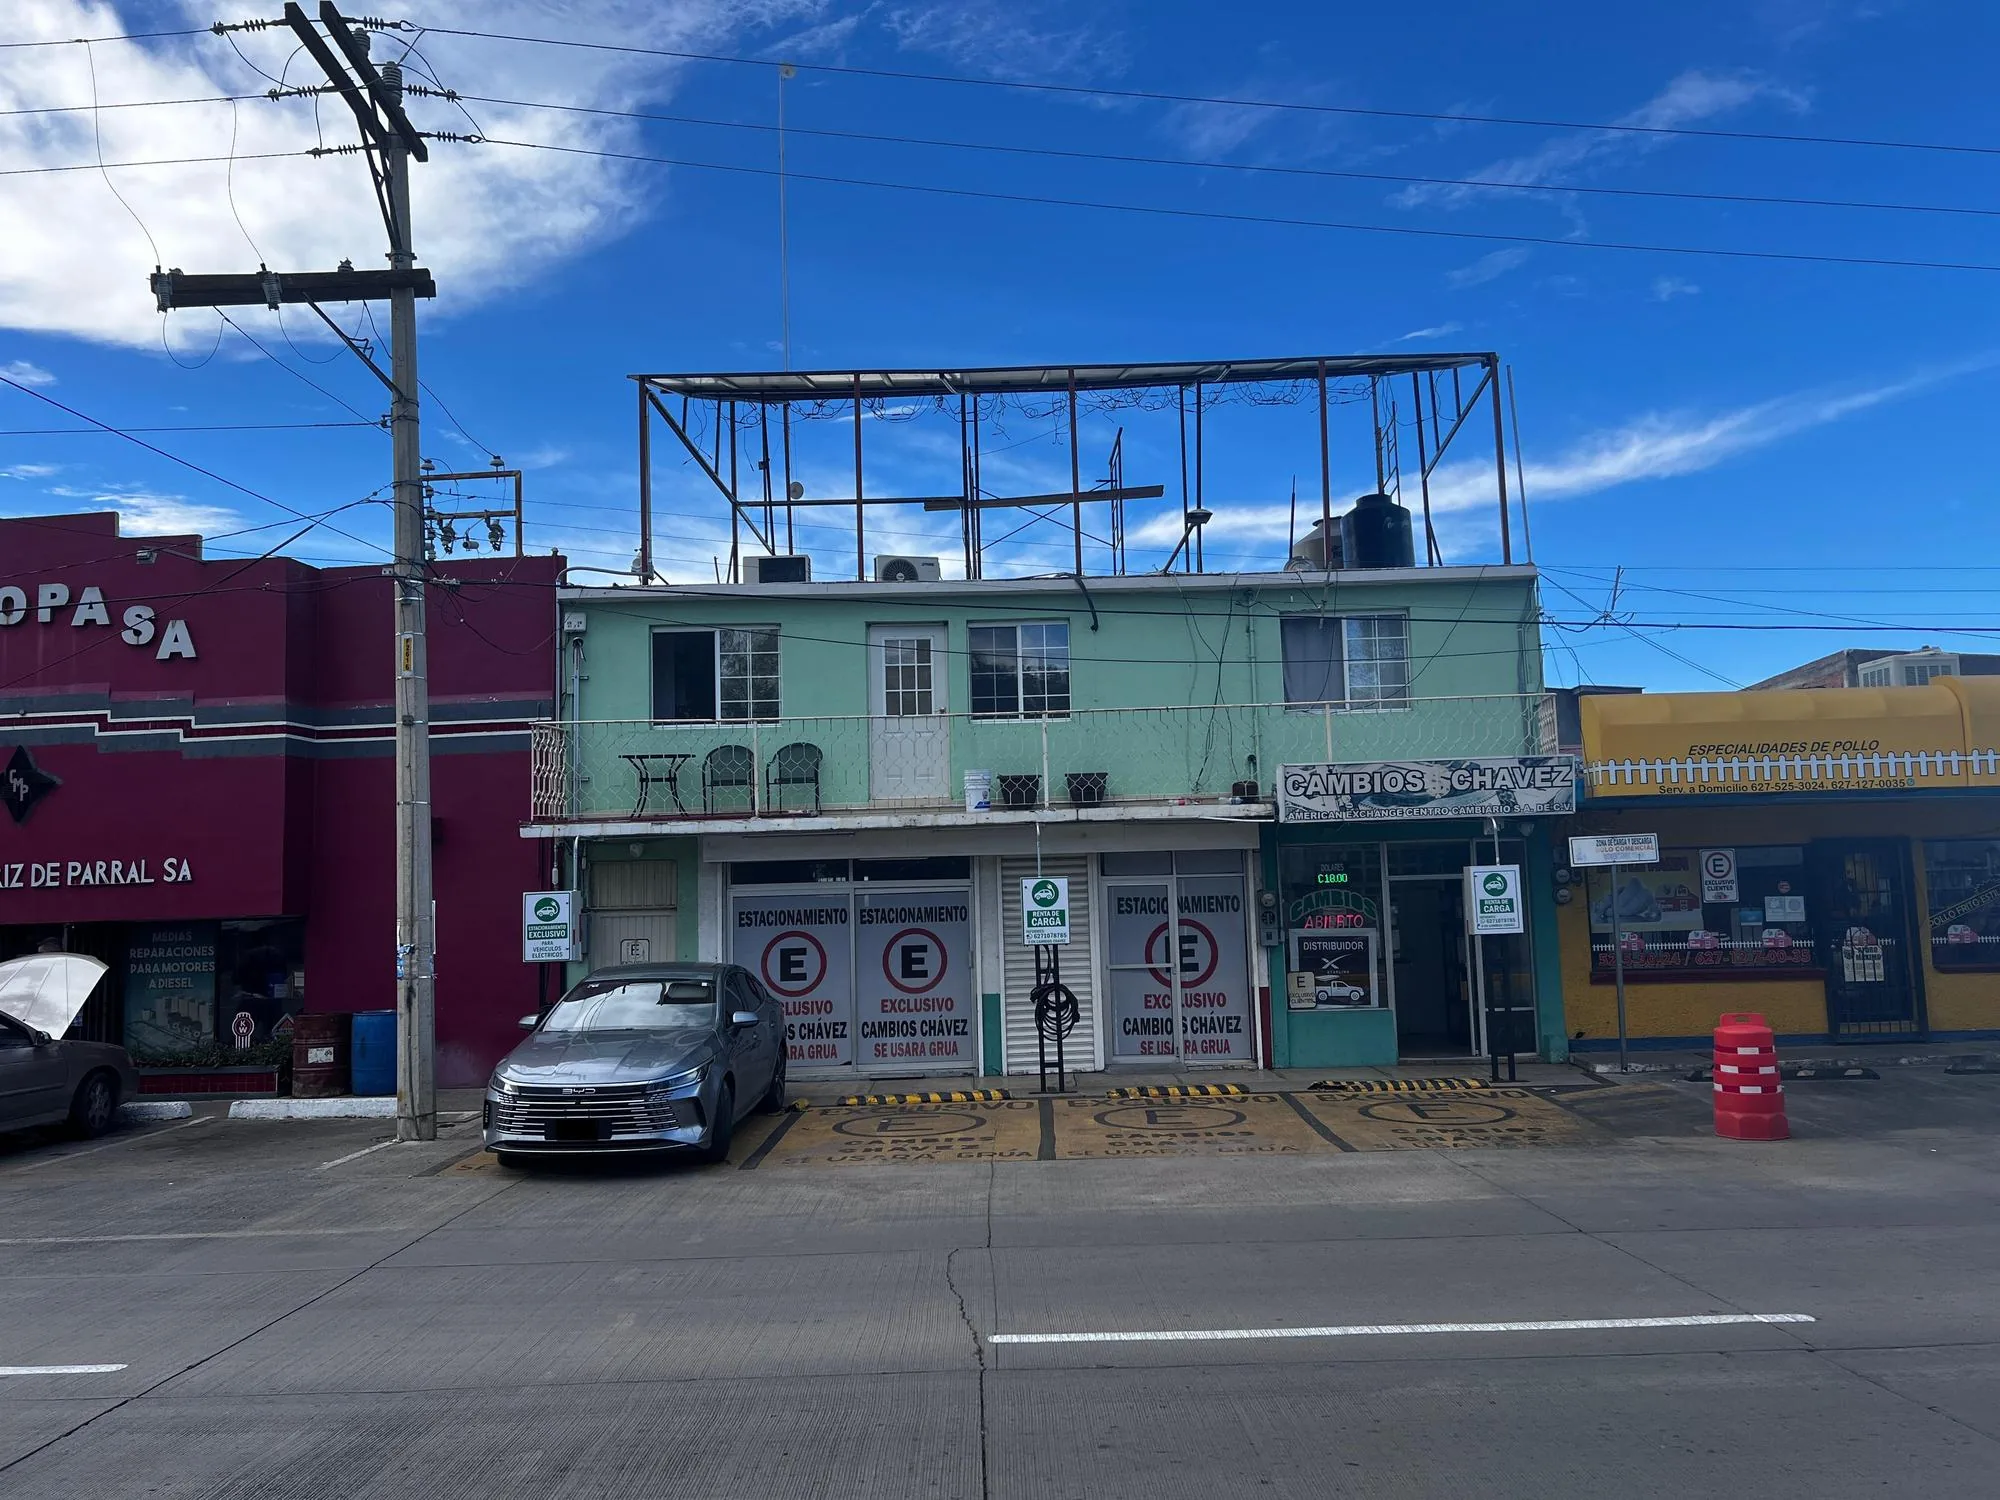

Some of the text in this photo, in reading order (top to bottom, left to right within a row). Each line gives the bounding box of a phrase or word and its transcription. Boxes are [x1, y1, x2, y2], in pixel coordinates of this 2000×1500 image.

[1688, 740, 1880, 756] ESPECIALIDADES DE POLLO
[1285, 769, 1425, 797] CAMBIOS
[1450, 765, 1574, 791] CHAVEZ
[1699, 784, 1749, 793] Domicilio
[1288, 811, 1343, 820] AMERICAN
[1346, 808, 1403, 819] EXCHANGE
[1406, 807, 1449, 816] CENTRO
[1451, 804, 1511, 814] CAMBIARIO
[1535, 803, 1550, 811] DE
[31, 862, 60, 887] DE
[67, 859, 155, 886] PARRAL
[163, 857, 192, 882] SA
[1713, 858, 1724, 873] E
[860, 906, 968, 925] ESTACIONAMIENTO
[1483, 904, 1511, 912] CARGA
[738, 908, 848, 928] ESTACIONAMIENTO
[1031, 917, 1062, 926] CARGA
[152, 931, 193, 942] MEDIAS
[528, 930, 566, 938] EXCLUSIVO
[129, 946, 215, 959] REPARACIONES
[1165, 935, 1200, 972] E
[1303, 941, 1364, 950] DISTRIBUIDOR
[130, 961, 215, 974] PARA MOTORES
[780, 947, 807, 982] E
[901, 944, 929, 979] E
[149, 977, 194, 989] A DIESEL
[1296, 976, 1306, 988] E
[881, 997, 954, 1013] EXCLUSIVO
[239, 1026, 248, 1034] W
[799, 1017, 848, 1040] CHÁVEZ
[861, 1014, 968, 1038] CAMBIOS CHÁVEZ
[1190, 1010, 1242, 1035] CHÁVEZ
[807, 1043, 838, 1060] GRUA
[874, 1040, 959, 1058] SE USARA GRUA
[1141, 1041, 1154, 1055] SE
[1201, 1039, 1231, 1054] GRUA
[1067, 1095, 1279, 1108] EXCLUSIVO
[1315, 1090, 1530, 1101] EXCLUSIVO
[820, 1101, 1034, 1116] EXCLUSIVO
[1145, 1109, 1193, 1124] E
[1406, 1103, 1469, 1119] E
[876, 1115, 941, 1132] E
[844, 1136, 996, 1146] CAMBIOS
